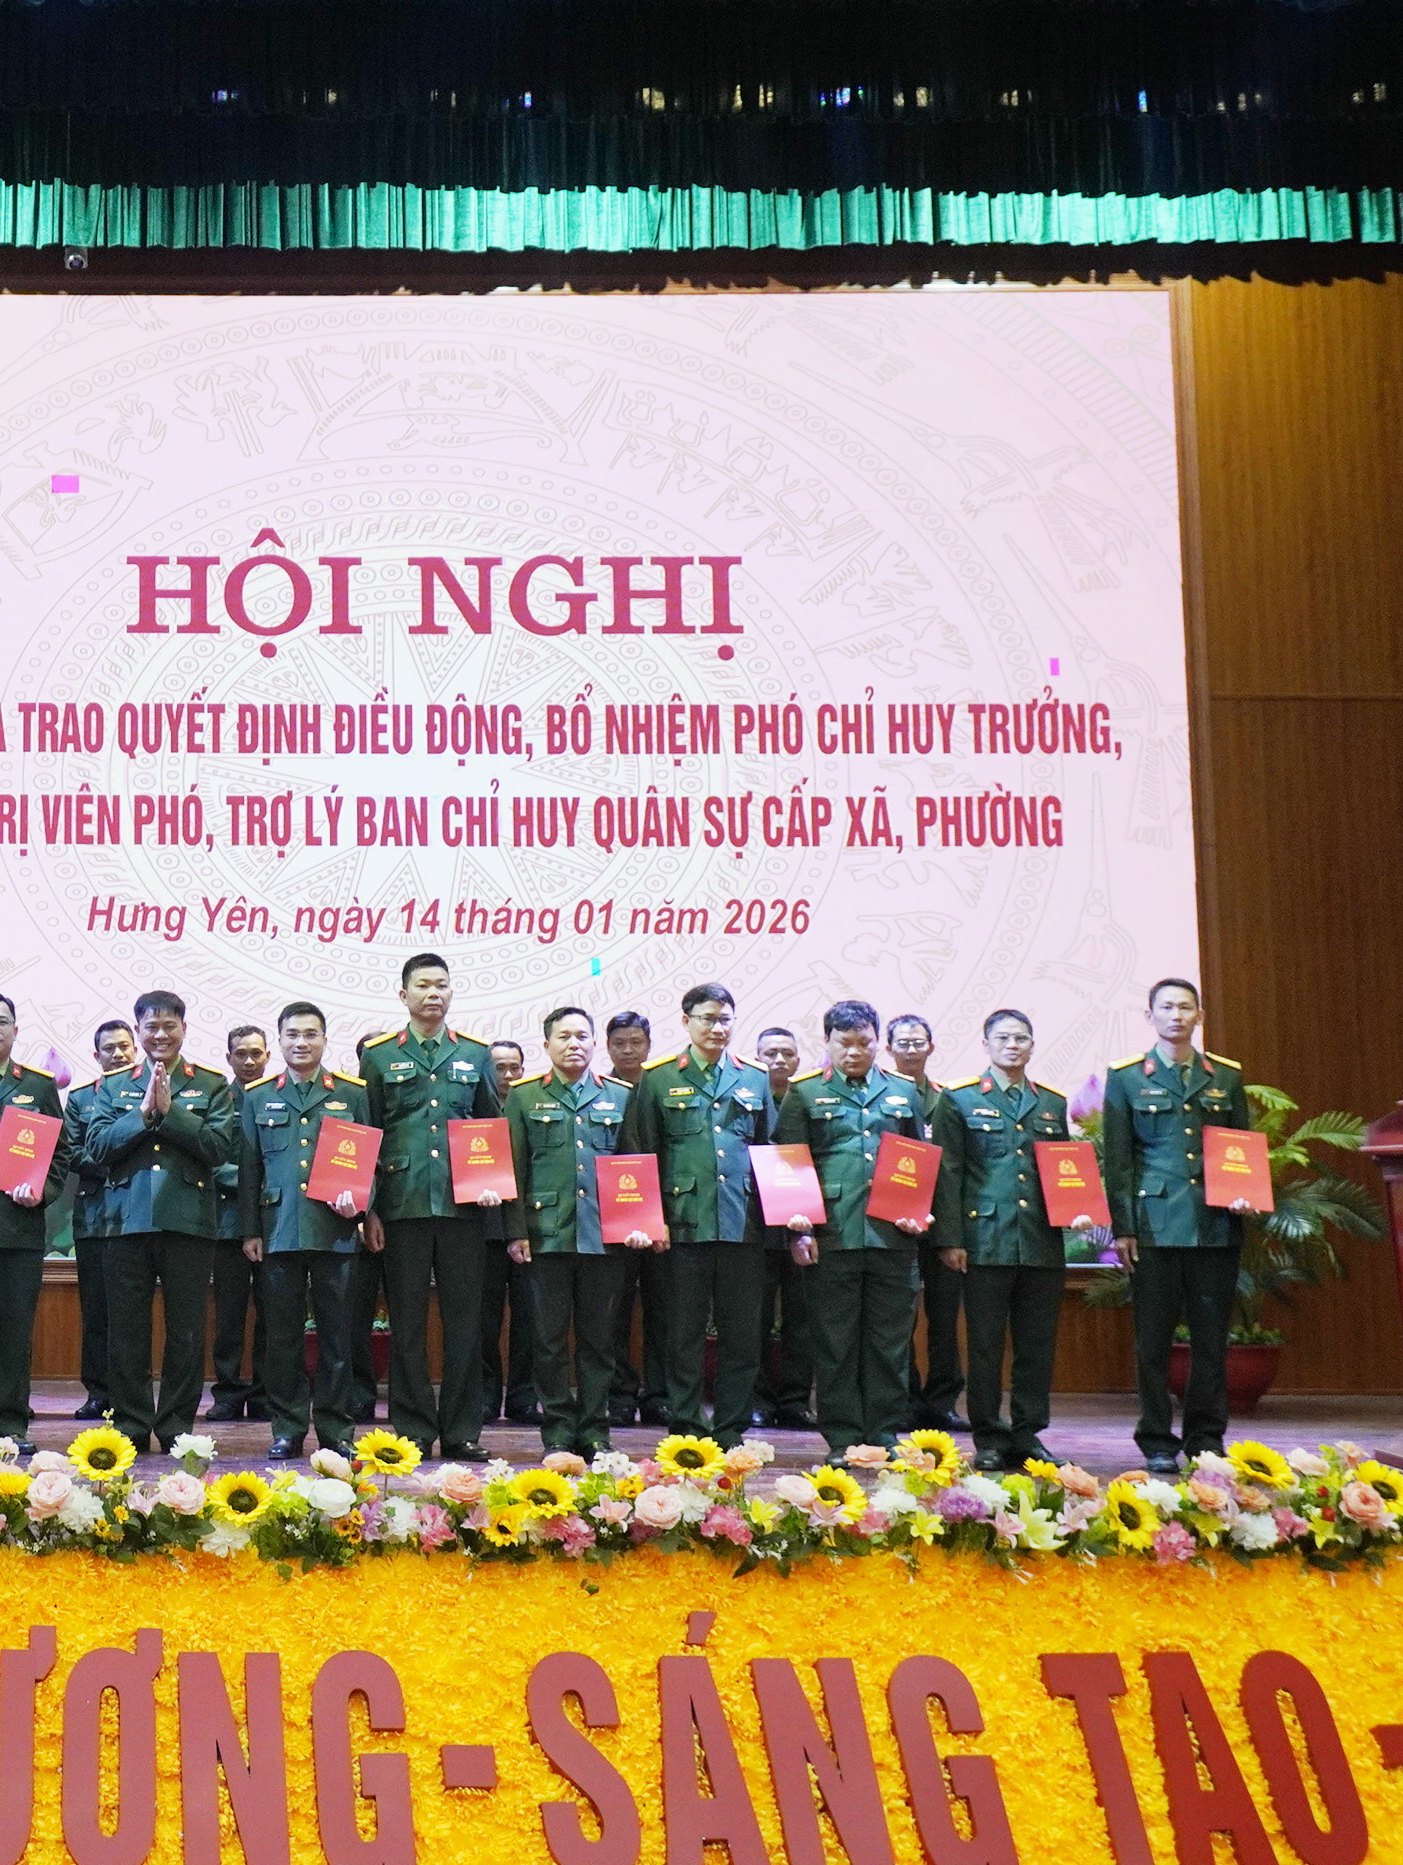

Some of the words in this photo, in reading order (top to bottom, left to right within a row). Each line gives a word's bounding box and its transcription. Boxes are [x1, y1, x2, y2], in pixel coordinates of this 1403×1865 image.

[127, 528, 362, 658] HỘI
[408, 555, 743, 660] NGHỊ
[18, 703, 103, 753] TRAO
[118, 687, 225, 759] QUYẾT
[237, 704, 320, 765] ĐỊNH
[334, 688, 412, 754] ĐIỀU
[426, 694, 532, 766] ĐỘNG,
[547, 684, 592, 755] BỔ
[606, 694, 720, 766] NHIỆM
[734, 693, 802, 754] PHÓ
[818, 686, 874, 754] CHỈ
[888, 704, 955, 754] HUY
[968, 686, 1121, 759] TRƯỞNG,
[42, 783, 120, 844] VIÊN
[134, 784, 213, 850] PHÓ,
[227, 791, 292, 858] TRỢ
[306, 786, 342, 845] LÝ
[357, 797, 428, 846] BAN
[442, 779, 498, 847] CHỈ
[513, 797, 579, 847] HUY
[594, 786, 689, 853] QUÂN
[704, 791, 752, 859] SỰ
[763, 778, 831, 847] CẤP
[846, 787, 902, 853] XÃ,
[916, 783, 1063, 847] PHƯỜNG
[88, 897, 186, 941] Hưng
[203, 896, 277, 938] Yên,
[295, 898, 385, 942] ngày
[401, 899, 439, 933] 14
[455, 900, 559, 943] tháng
[574, 900, 612, 934] 01
[630, 901, 708, 934] năm
[724, 899, 809, 934] 2026
[526, 1610, 1019, 1865] SÁNG
